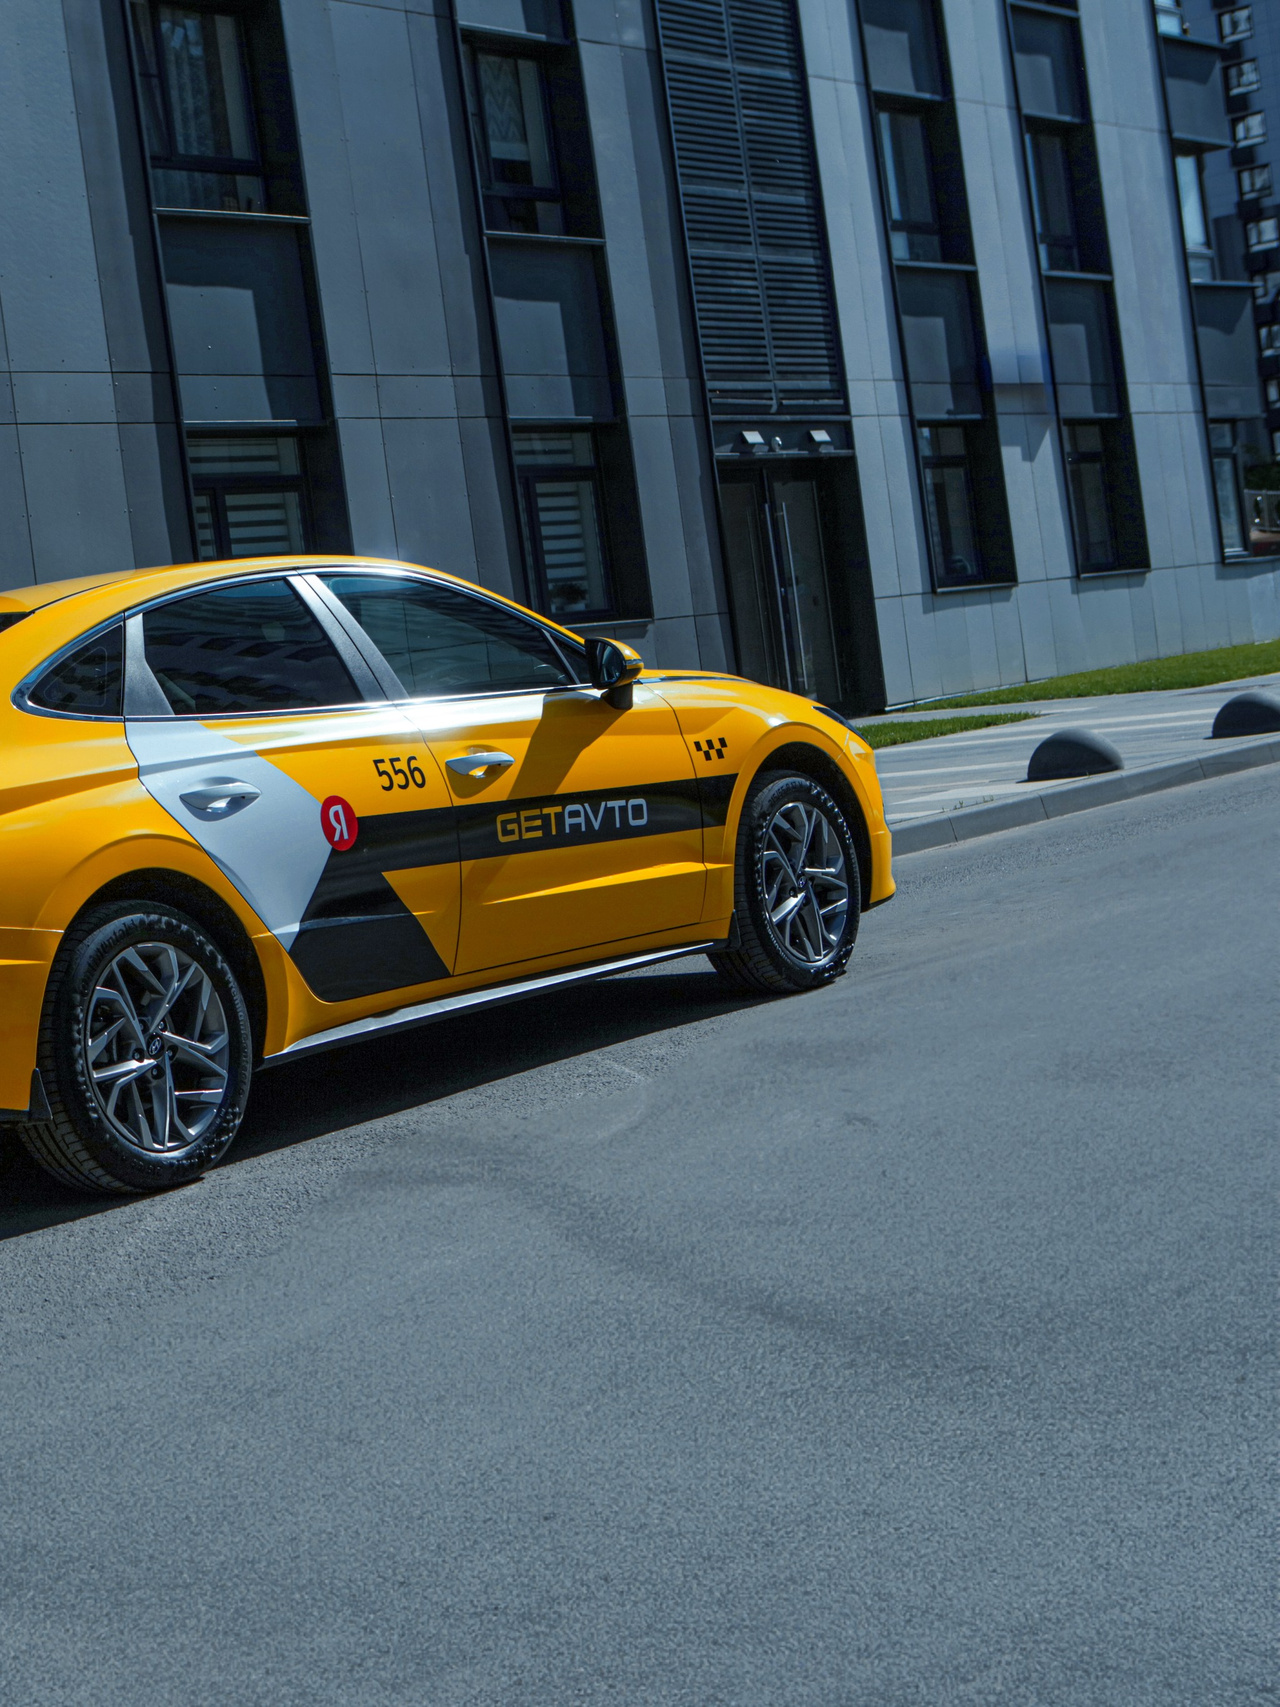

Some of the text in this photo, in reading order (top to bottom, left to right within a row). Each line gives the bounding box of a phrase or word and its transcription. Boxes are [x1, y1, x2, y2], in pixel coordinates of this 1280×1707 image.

[372, 755, 426, 791] 556
[329, 805, 348, 842] Я
[496, 798, 648, 843] GETAVTO
